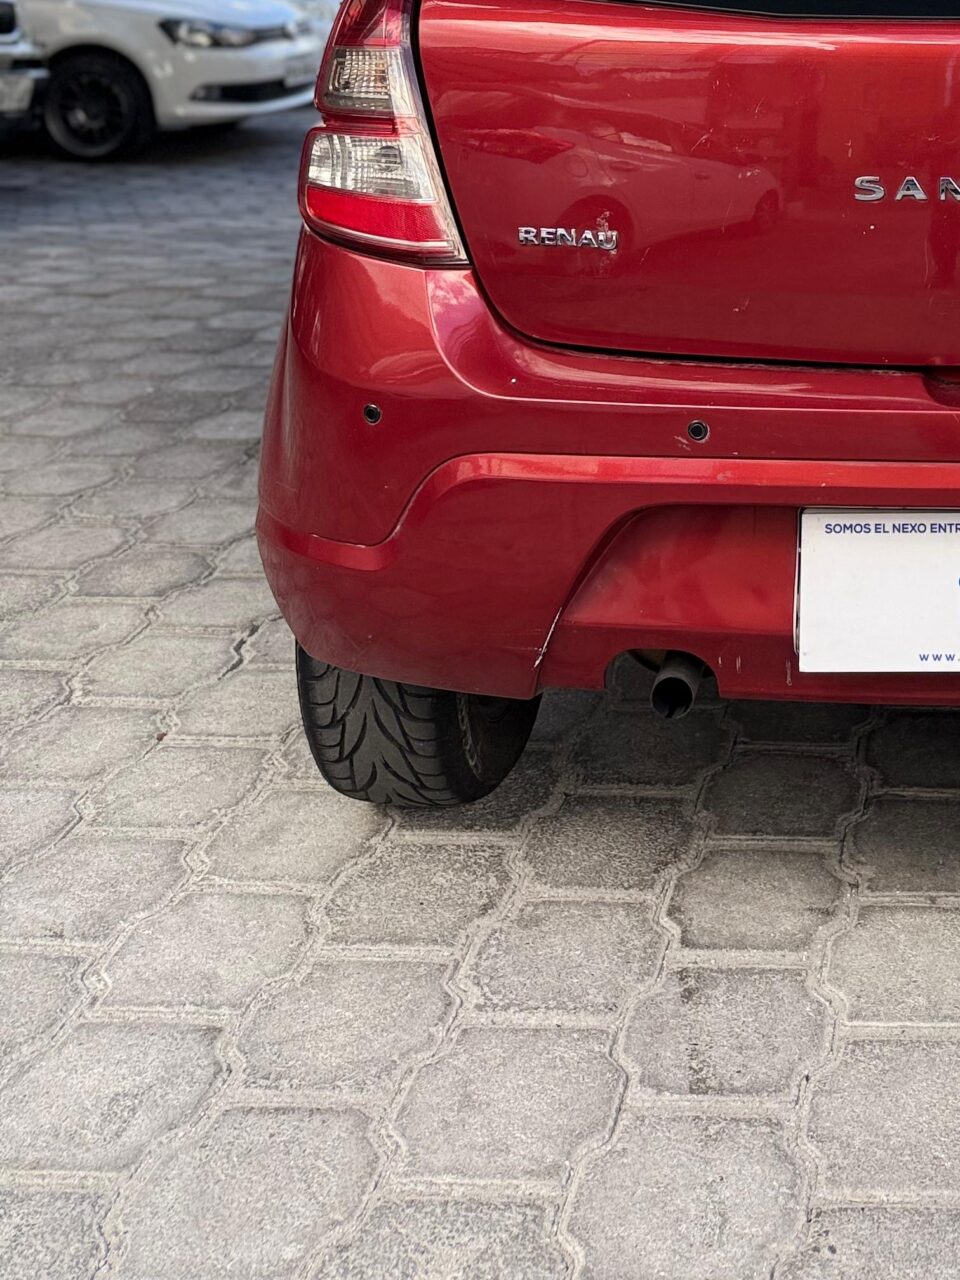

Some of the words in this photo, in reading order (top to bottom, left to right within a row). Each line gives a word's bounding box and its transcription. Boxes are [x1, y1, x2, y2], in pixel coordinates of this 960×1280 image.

[824, 523, 872, 534] SOMOS
[874, 523, 890, 534] EL
[892, 523, 927, 534] NEXO
